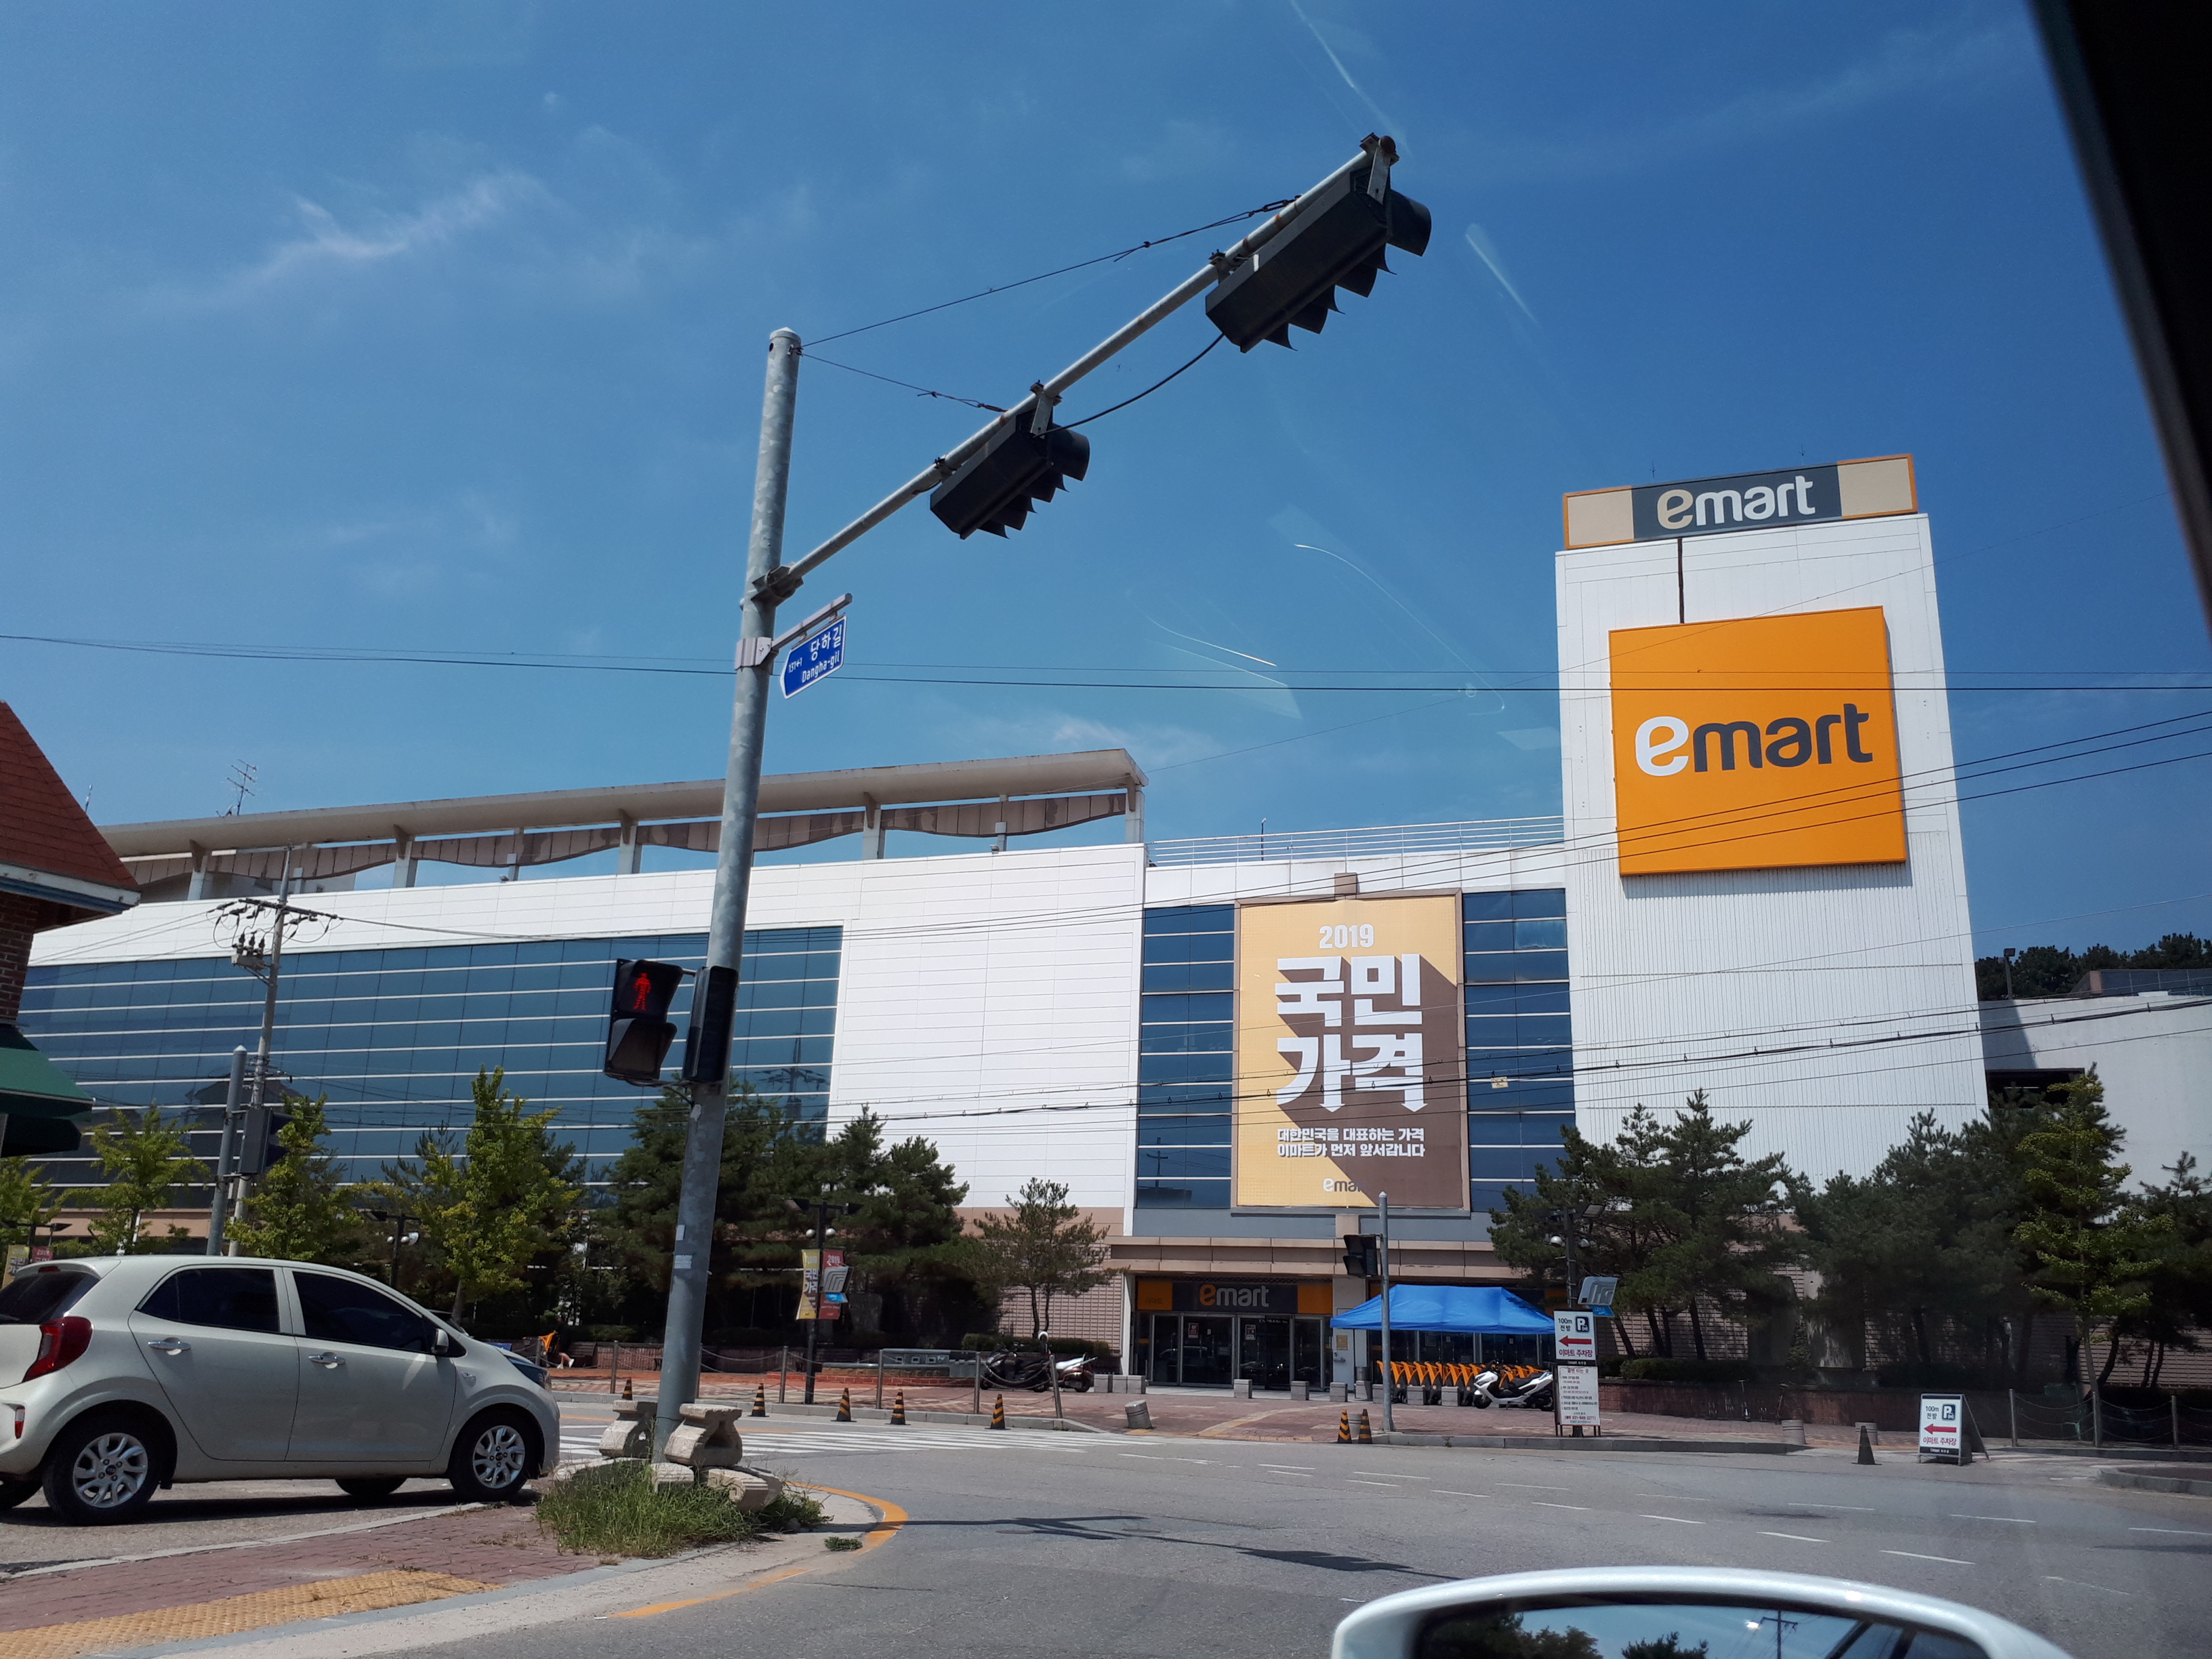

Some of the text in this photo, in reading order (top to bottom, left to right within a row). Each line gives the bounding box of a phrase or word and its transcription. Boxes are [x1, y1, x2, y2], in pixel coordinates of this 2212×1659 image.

[1657, 475, 1816, 529] emart
[811, 624, 842, 661] 당하길
[802, 651, 840, 683] Dangha-gil
[1635, 703, 1873, 777] emart
[1319, 924, 1374, 949] 2019
[1275, 954, 1422, 1027] 국민
[1276, 1033, 1428, 1113] 가격
[1277, 1128, 1425, 1142] 대한민국을 대표하는 가격
[1277, 1143, 1425, 1158] 이마트가 먼저 앞서갑니다
[827, 1254, 840, 1263] 2019
[1200, 1284, 1269, 1307] emart
[1577, 1318, 1586, 1331] P
[1576, 1349, 1593, 1357] 주차장
[1943, 1406, 1952, 1419] P
[1940, 1437, 1957, 1446] 주차장
